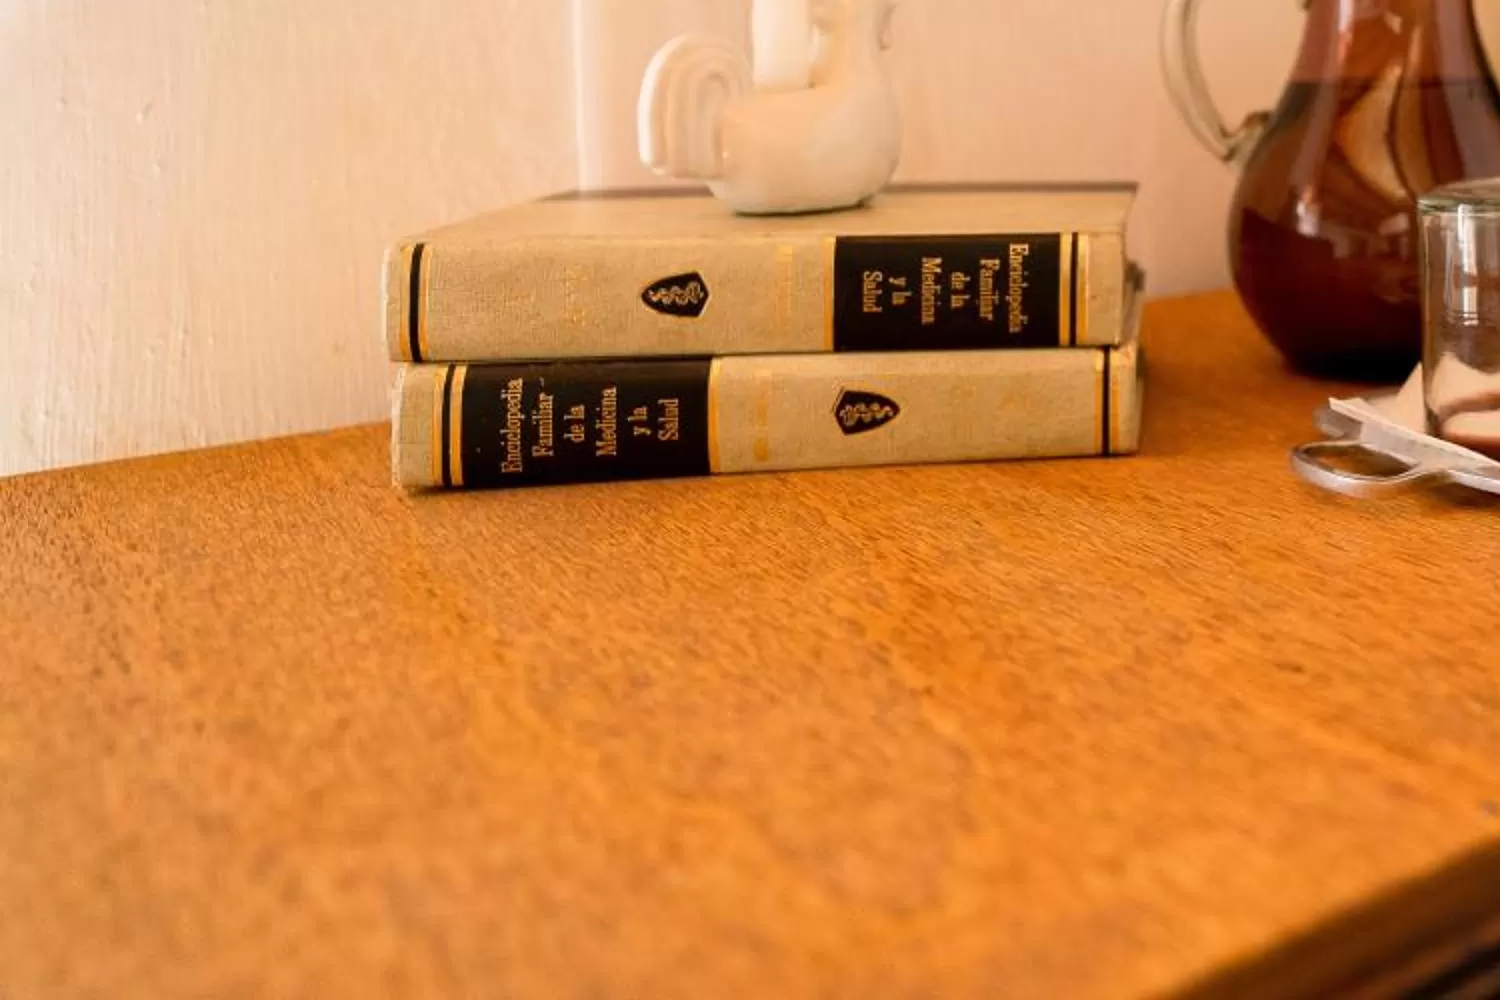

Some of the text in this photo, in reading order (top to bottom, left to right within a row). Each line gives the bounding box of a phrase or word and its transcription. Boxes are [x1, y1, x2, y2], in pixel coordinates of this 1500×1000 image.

[862, 271, 883, 313] Salud
[888, 276, 912, 306] y la
[921, 257, 943, 325] Medicina
[951, 272, 970, 309] de la
[979, 258, 1001, 321] Familiar
[1005, 243, 1029, 333] Enciclopedia
[501, 377, 525, 473] Enciclopedia
[532, 392, 554, 457] Familiar
[564, 404, 585, 443] de la
[596, 385, 617, 456] Medicina
[627, 405, 653, 436] y la
[657, 398, 679, 441] Salud
